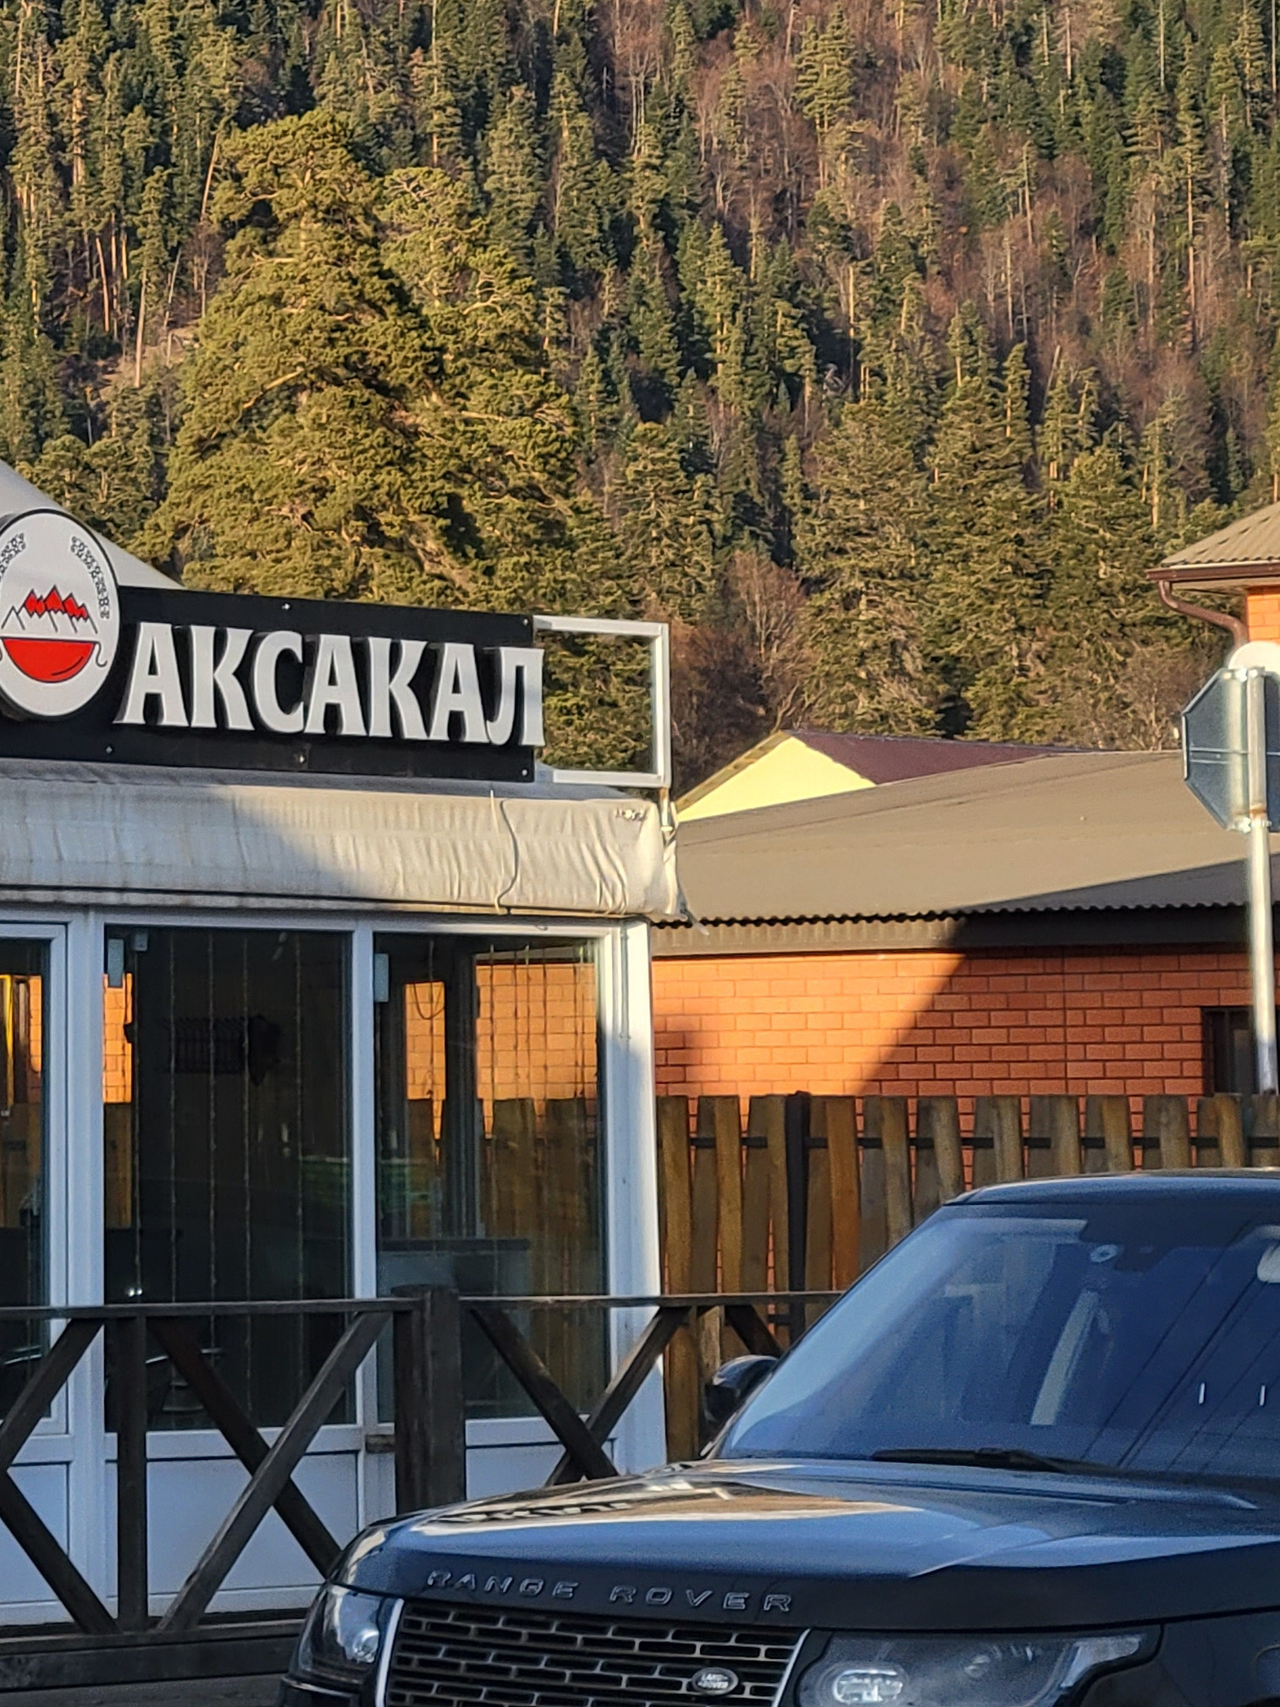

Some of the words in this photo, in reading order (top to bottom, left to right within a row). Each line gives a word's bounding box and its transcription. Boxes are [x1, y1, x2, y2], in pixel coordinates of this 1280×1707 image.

[114, 621, 546, 747] АКСАКАЛ
[427, 1569, 579, 1598] RANGE
[609, 1585, 793, 1613] ROVER
